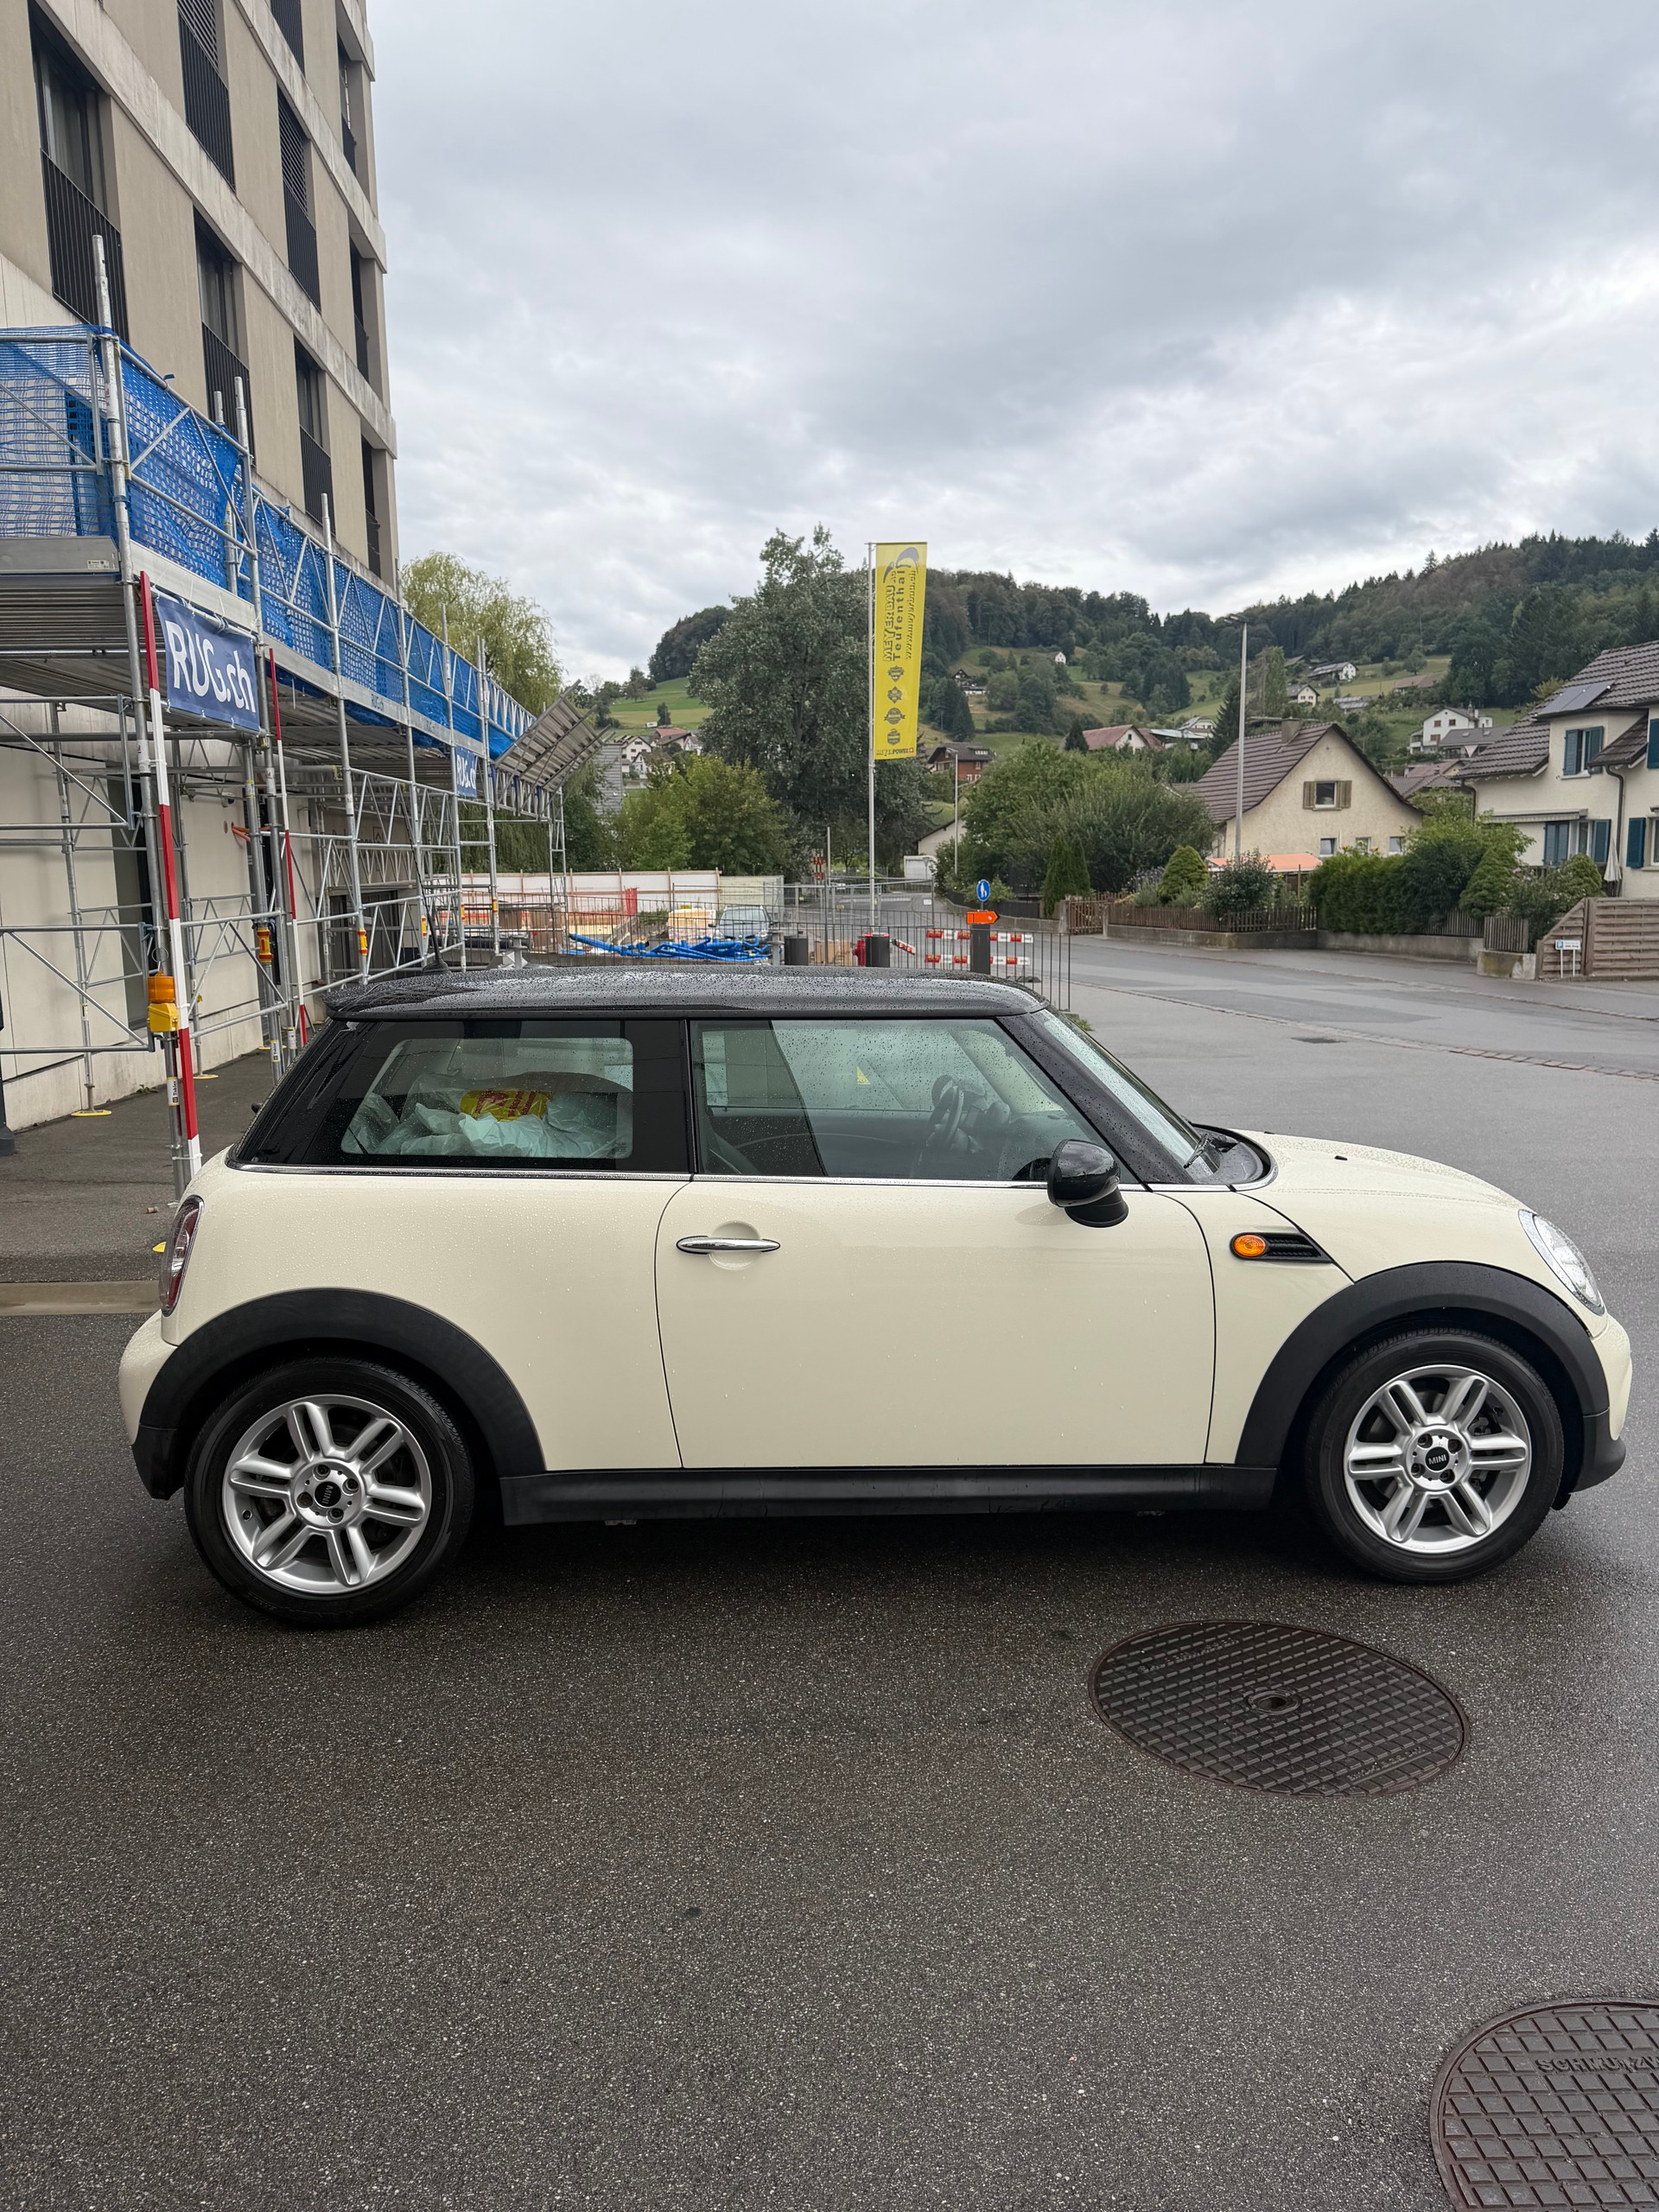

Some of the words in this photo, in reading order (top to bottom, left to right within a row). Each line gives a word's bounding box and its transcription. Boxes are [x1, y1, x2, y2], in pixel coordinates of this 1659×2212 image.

[893, 570, 906, 662] Teufenthal
[905, 570, 916, 660] www.meyerbau.ch
[165, 620, 256, 713] RUG.ch
[321, 1485, 334, 1504] MINI
[1427, 1453, 1447, 1465] MINI
